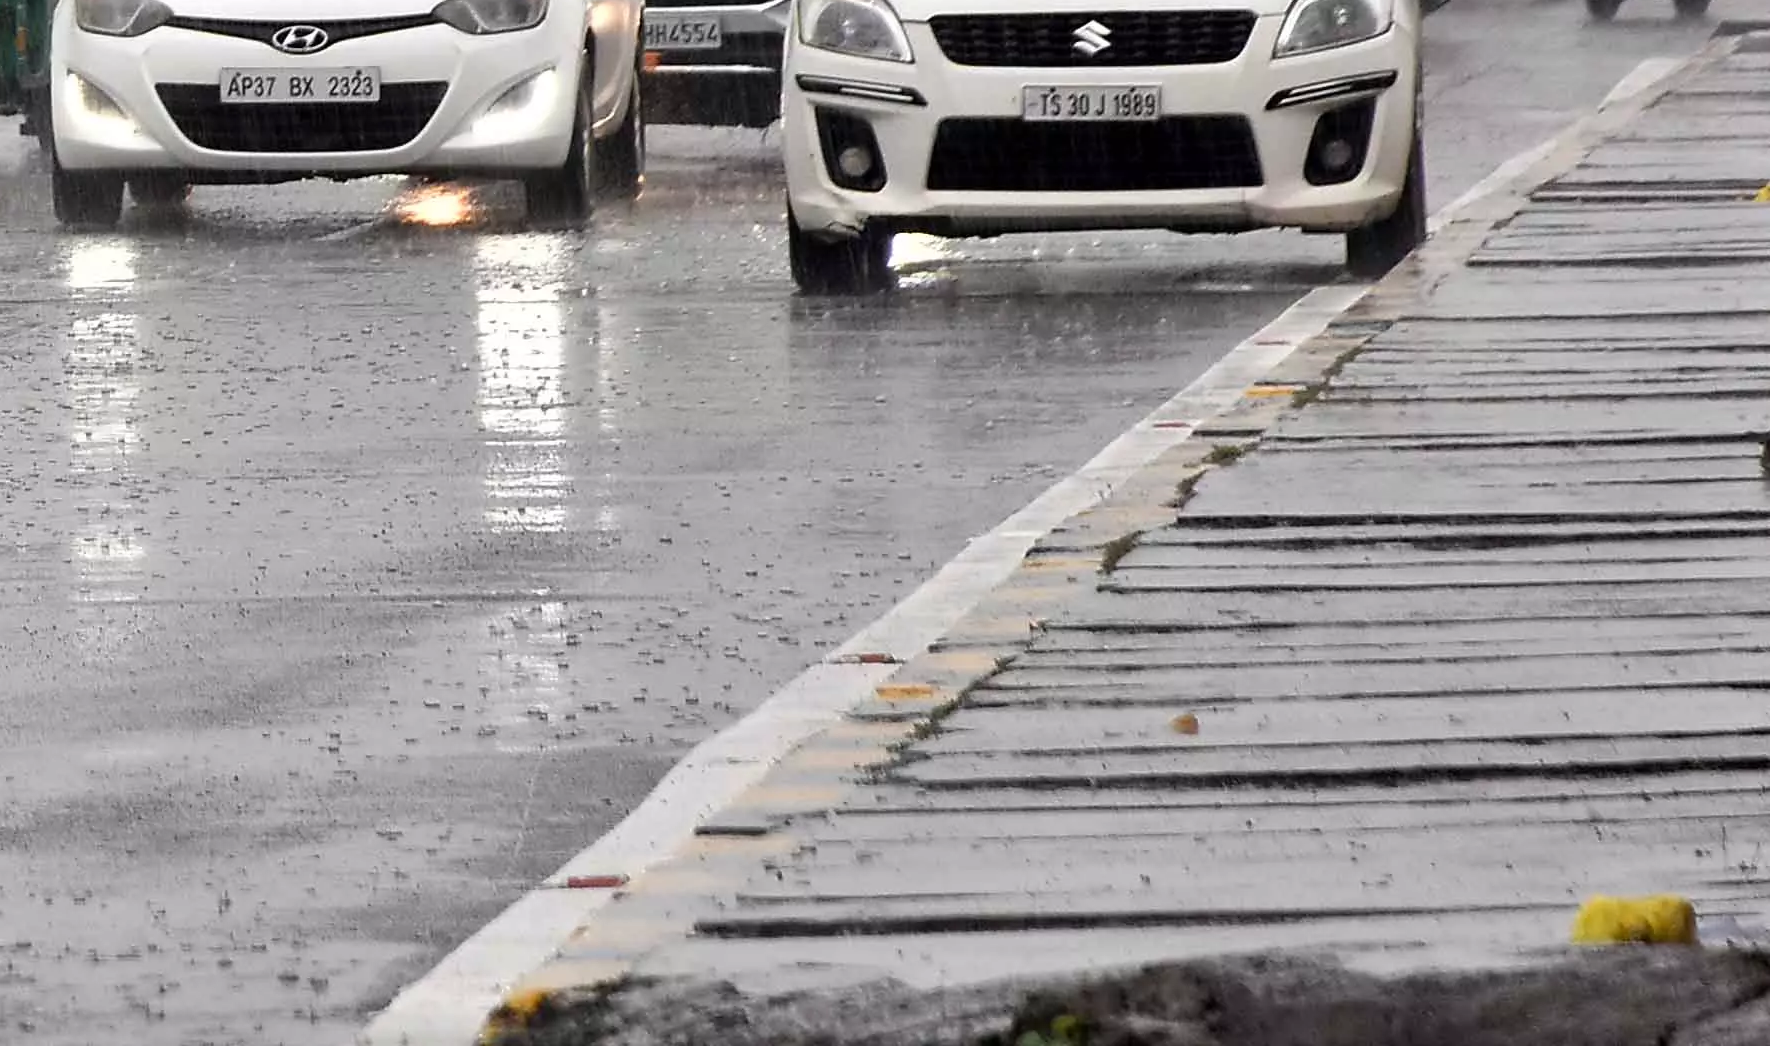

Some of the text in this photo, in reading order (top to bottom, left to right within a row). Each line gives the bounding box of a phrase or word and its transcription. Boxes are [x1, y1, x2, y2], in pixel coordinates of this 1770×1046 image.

[227, 76, 373, 97] AP37 BX 2323
[1041, 93, 1156, 116] TS 30 J 1989
